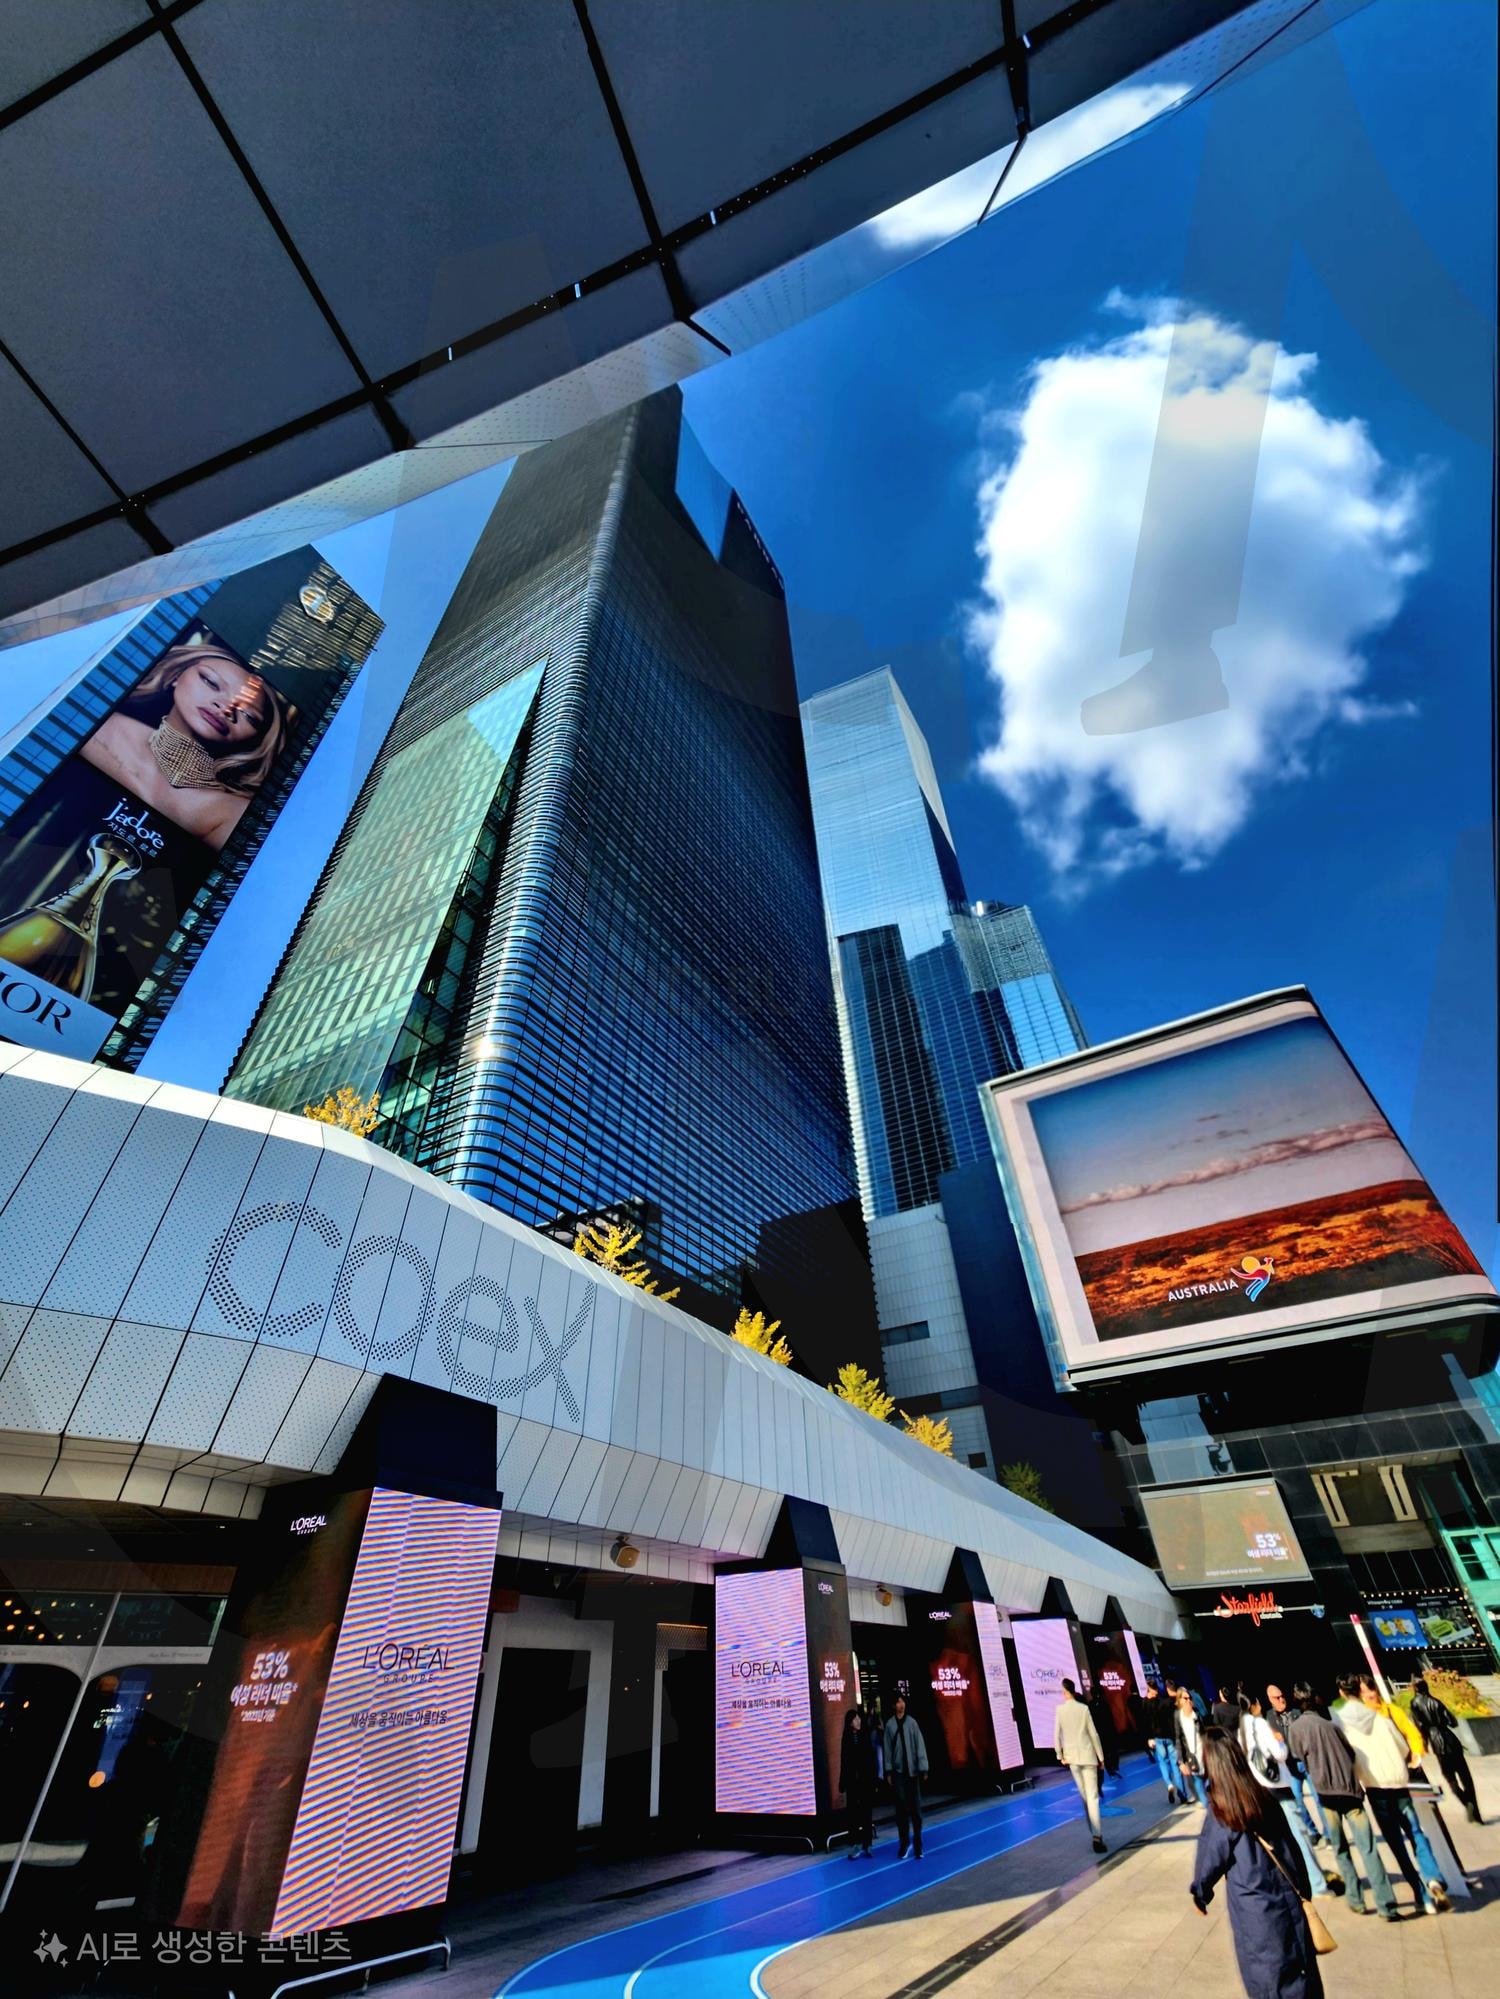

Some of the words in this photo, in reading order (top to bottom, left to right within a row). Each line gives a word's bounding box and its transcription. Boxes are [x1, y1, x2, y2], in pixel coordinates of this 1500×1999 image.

[1168, 1279, 1239, 1302] AUSTRALIA
[290, 1515, 328, 1532] L'ORÉAL
[1215, 1590, 1279, 1627] Starfield
[250, 1650, 291, 1681] 53%
[363, 1643, 455, 1671] L'ORÉAL
[383, 1673, 434, 1683] GROUPE
[731, 1660, 791, 1678] L'ORÉAL
[824, 1662, 841, 1678] 53%
[938, 1667, 962, 1680] 53%
